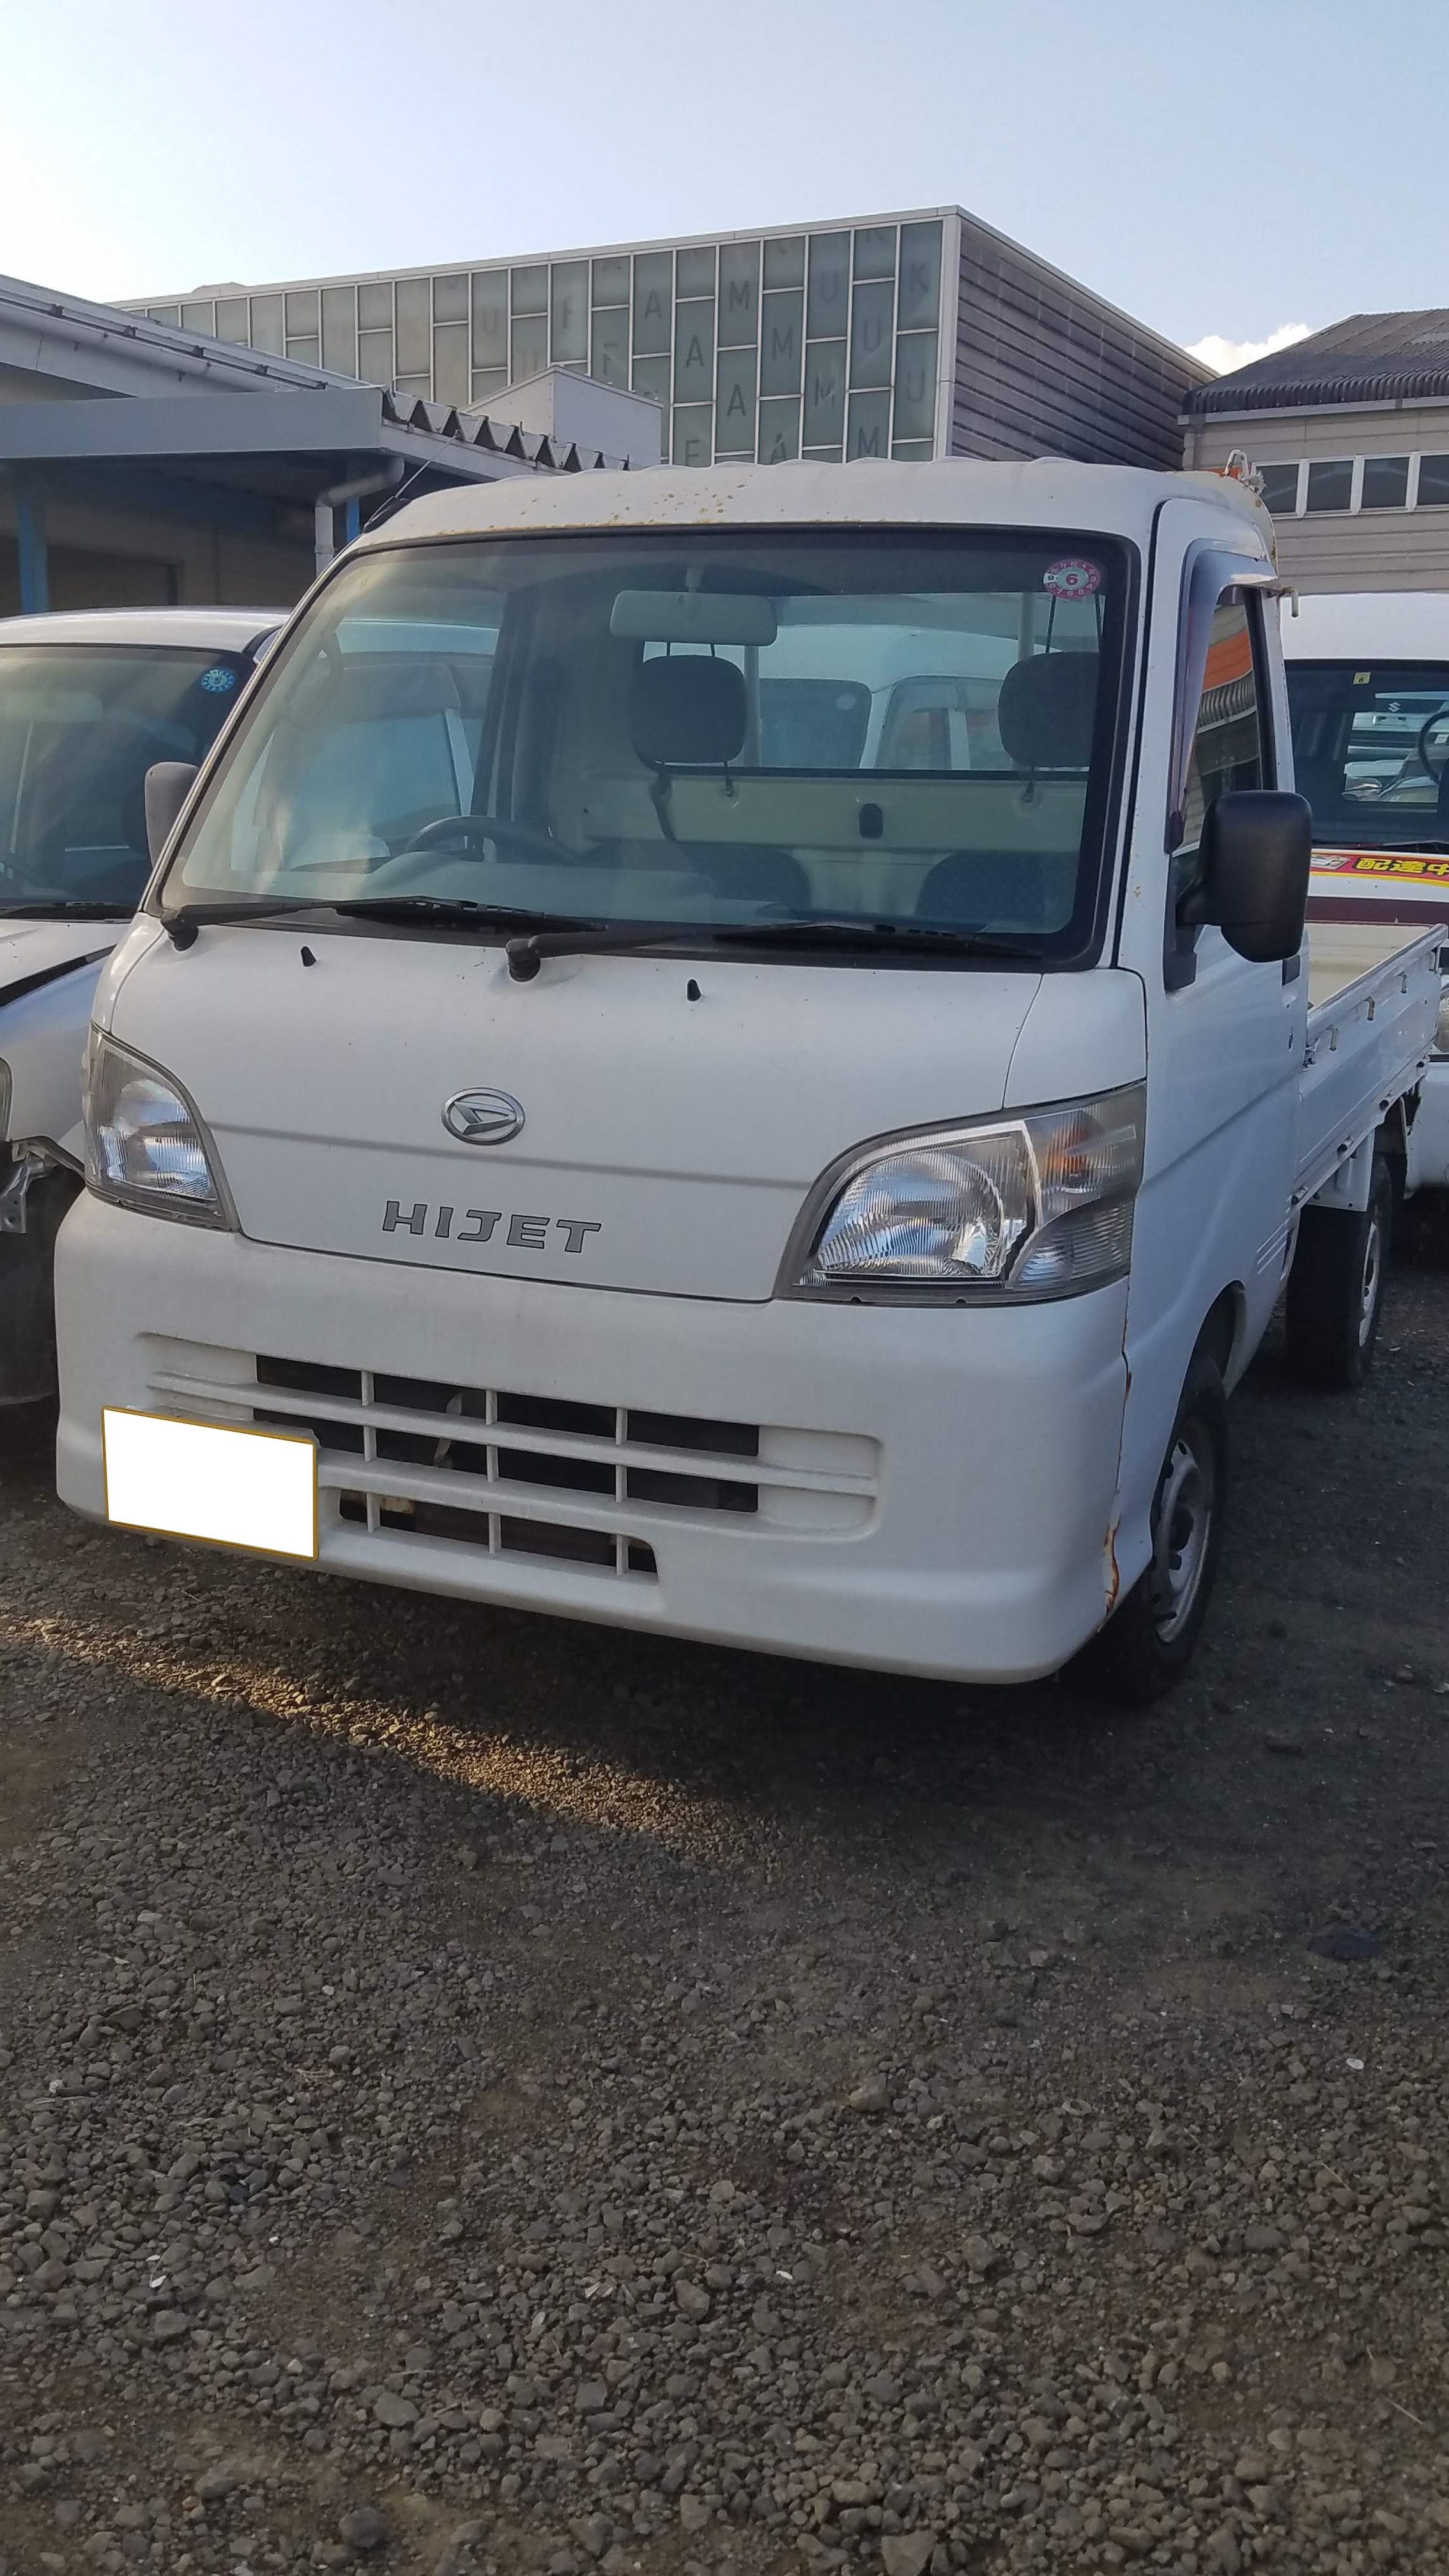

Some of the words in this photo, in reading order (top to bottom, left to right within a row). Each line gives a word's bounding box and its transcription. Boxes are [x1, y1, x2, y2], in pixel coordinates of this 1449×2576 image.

[644, 291, 663, 320] A
[728, 280, 750, 312] M
[820, 271, 839, 302] U
[910, 262, 930, 293] K
[686, 334, 704, 368] A
[772, 326, 793, 360] M
[864, 319, 882, 351] U
[726, 384, 746, 417] A
[907, 368, 925, 403] U
[858, 425, 879, 458] M
[1066, 573, 1078, 586] 6
[382, 1200, 602, 1254] HIJET
